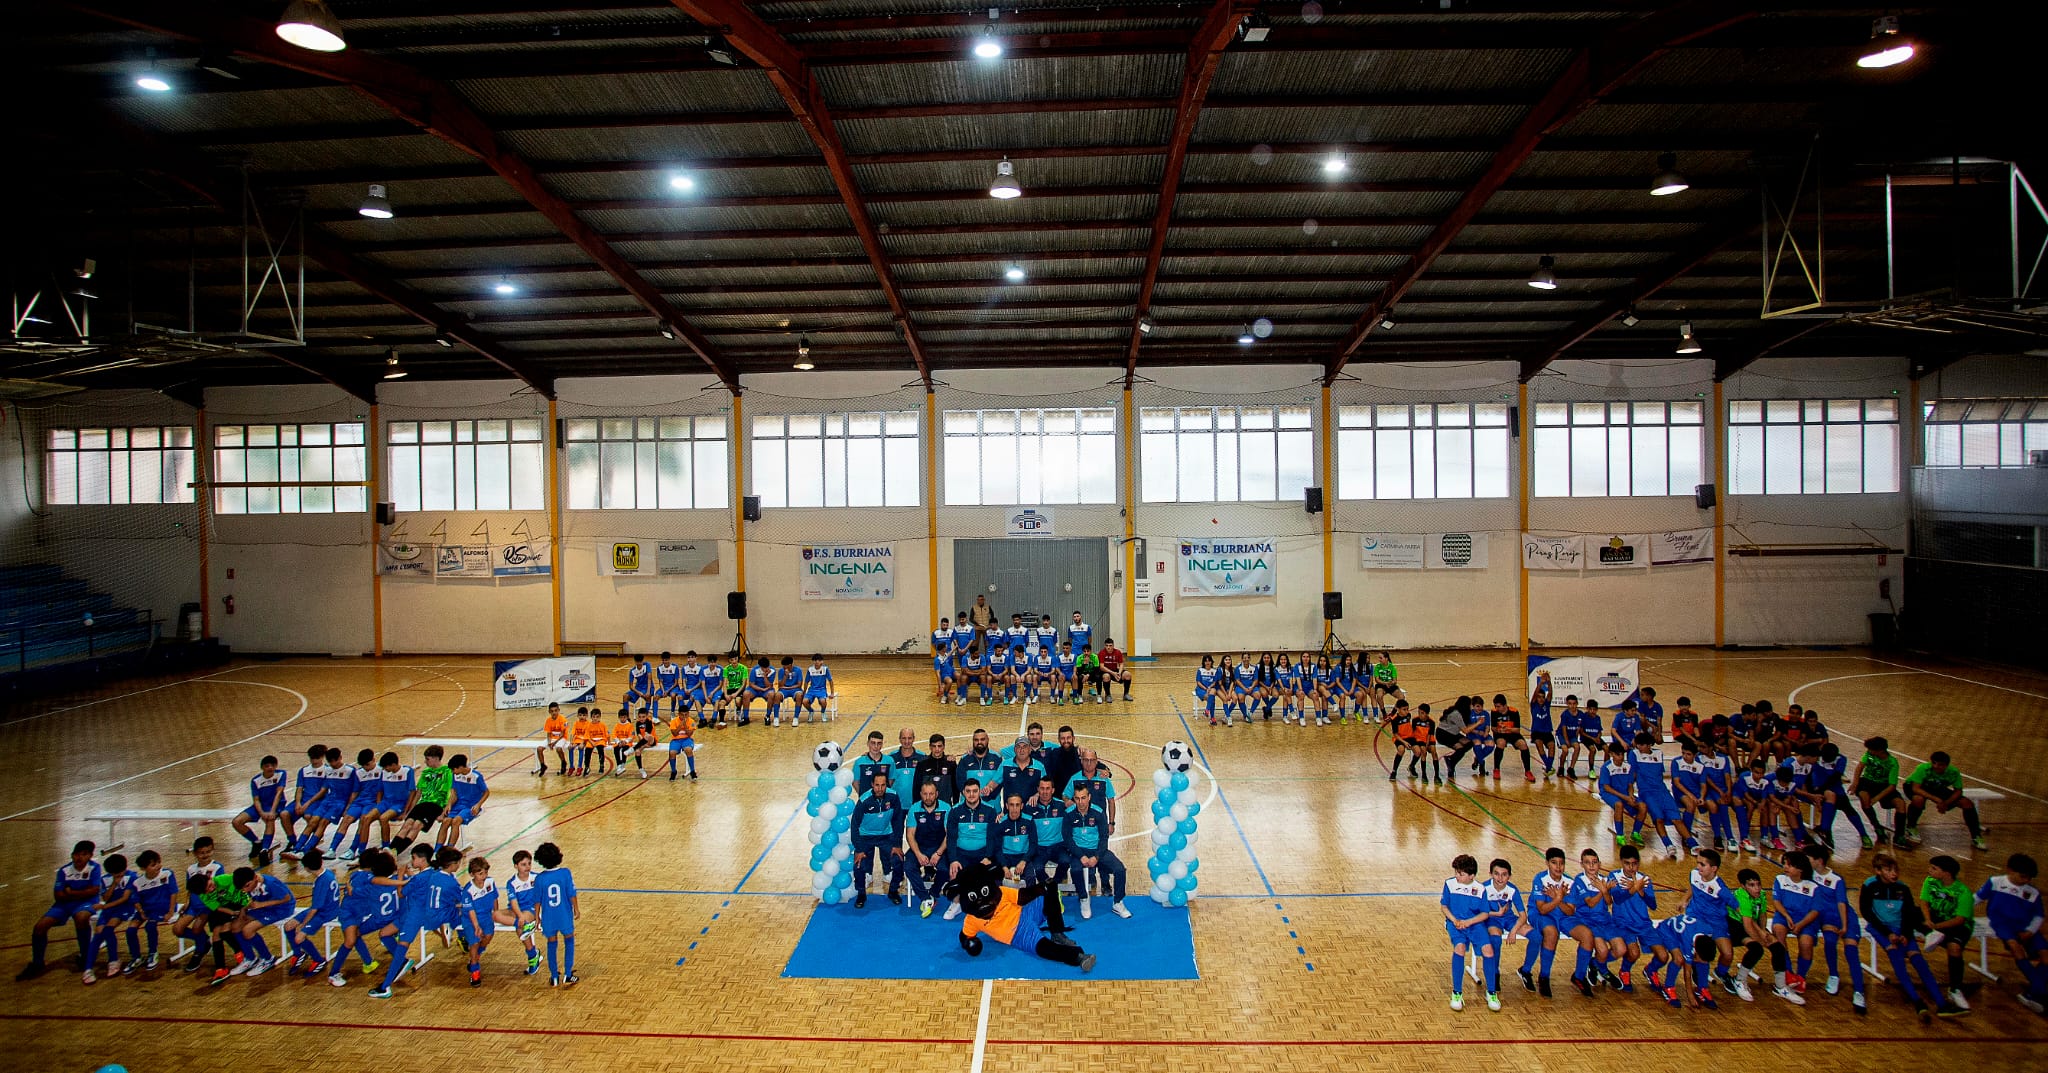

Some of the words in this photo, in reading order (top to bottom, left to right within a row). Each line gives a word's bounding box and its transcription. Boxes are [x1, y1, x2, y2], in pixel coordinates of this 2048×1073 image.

[813, 548, 831, 558] F.S.
[833, 547, 892, 558] BURRIANA
[1193, 544, 1210, 554] F.S.
[1213, 543, 1273, 554] BURRIANA
[809, 562, 888, 575] INGENIA
[1188, 558, 1268, 571] INGENIA
[430, 885, 442, 909] 11
[547, 883, 562, 907] 9
[379, 888, 400, 916] 21
